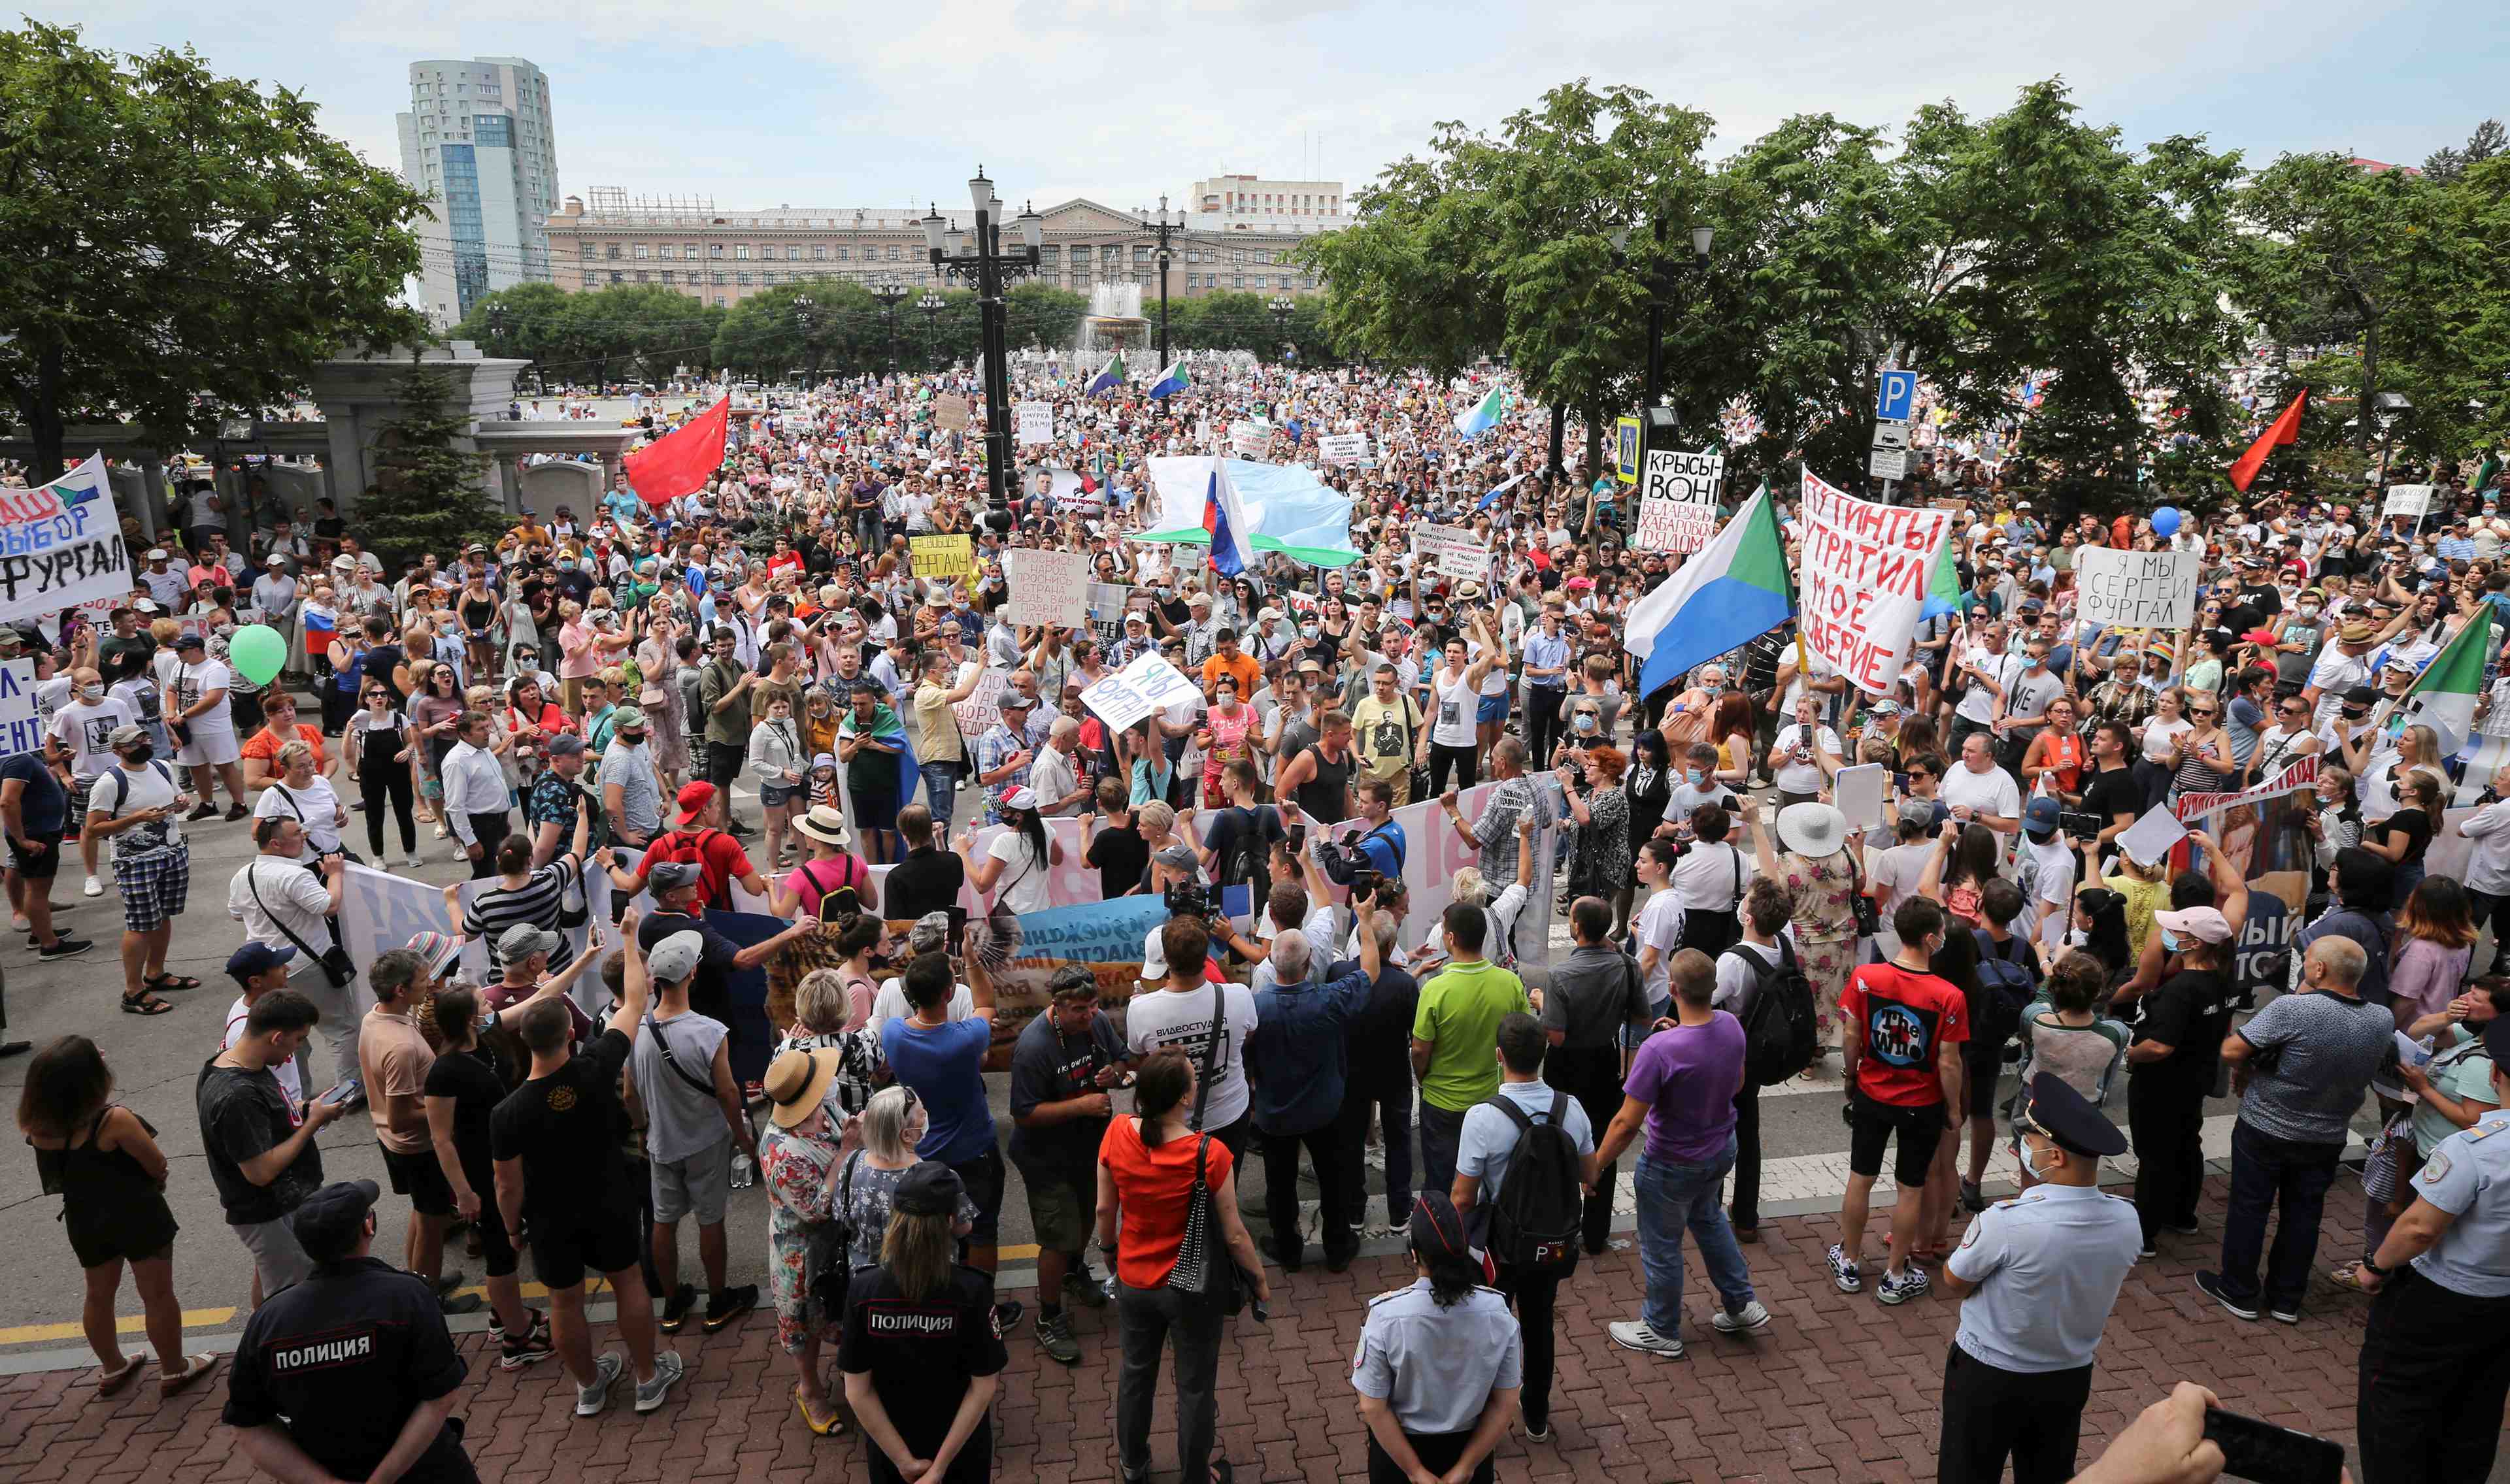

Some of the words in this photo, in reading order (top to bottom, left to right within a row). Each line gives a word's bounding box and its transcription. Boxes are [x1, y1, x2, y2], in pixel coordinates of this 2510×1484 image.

[1885, 376, 1906, 412] P
[1650, 453, 1721, 476] КРЫСЫ-
[1649, 474, 1720, 506] ВОН!
[0, 489, 58, 527] АШ
[1643, 501, 1711, 522] БЕЛАРУСЬ
[0, 506, 88, 555] ЫБОР
[1641, 515, 1714, 537] ХАБАРОВСК
[1417, 539, 1443, 550] ЗАСЛАН
[1642, 530, 1704, 554] РЯДОМ
[1017, 552, 1075, 566] ПРОСНИСЬ
[1803, 515, 1924, 601] УТРАТИЛ
[2118, 555, 2128, 576] Я
[2143, 555, 2176, 577] МЫ
[1016, 572, 1073, 586] ПРОСНИСЬ
[1031, 565, 1067, 576] НАРОД
[1023, 584, 1065, 595] СТРАНА
[2092, 572, 2188, 600] СЕРГЕЙ
[1015, 593, 1043, 602] ВЕДЬ
[1051, 595, 1079, 607] ВАМИ
[1021, 603, 1065, 614] ПРАВИТ
[1812, 570, 1873, 632] МОЁ
[2088, 595, 2173, 623] ФУРГАЛ
[1020, 613, 1063, 623] САТАНА
[1881, 1009, 1920, 1038] The
[1872, 1029, 1922, 1061] Who
[872, 1314, 953, 1333] ПОЛИЦИЯ
[275, 1336, 370, 1370] ПОЛИЦИЯ
